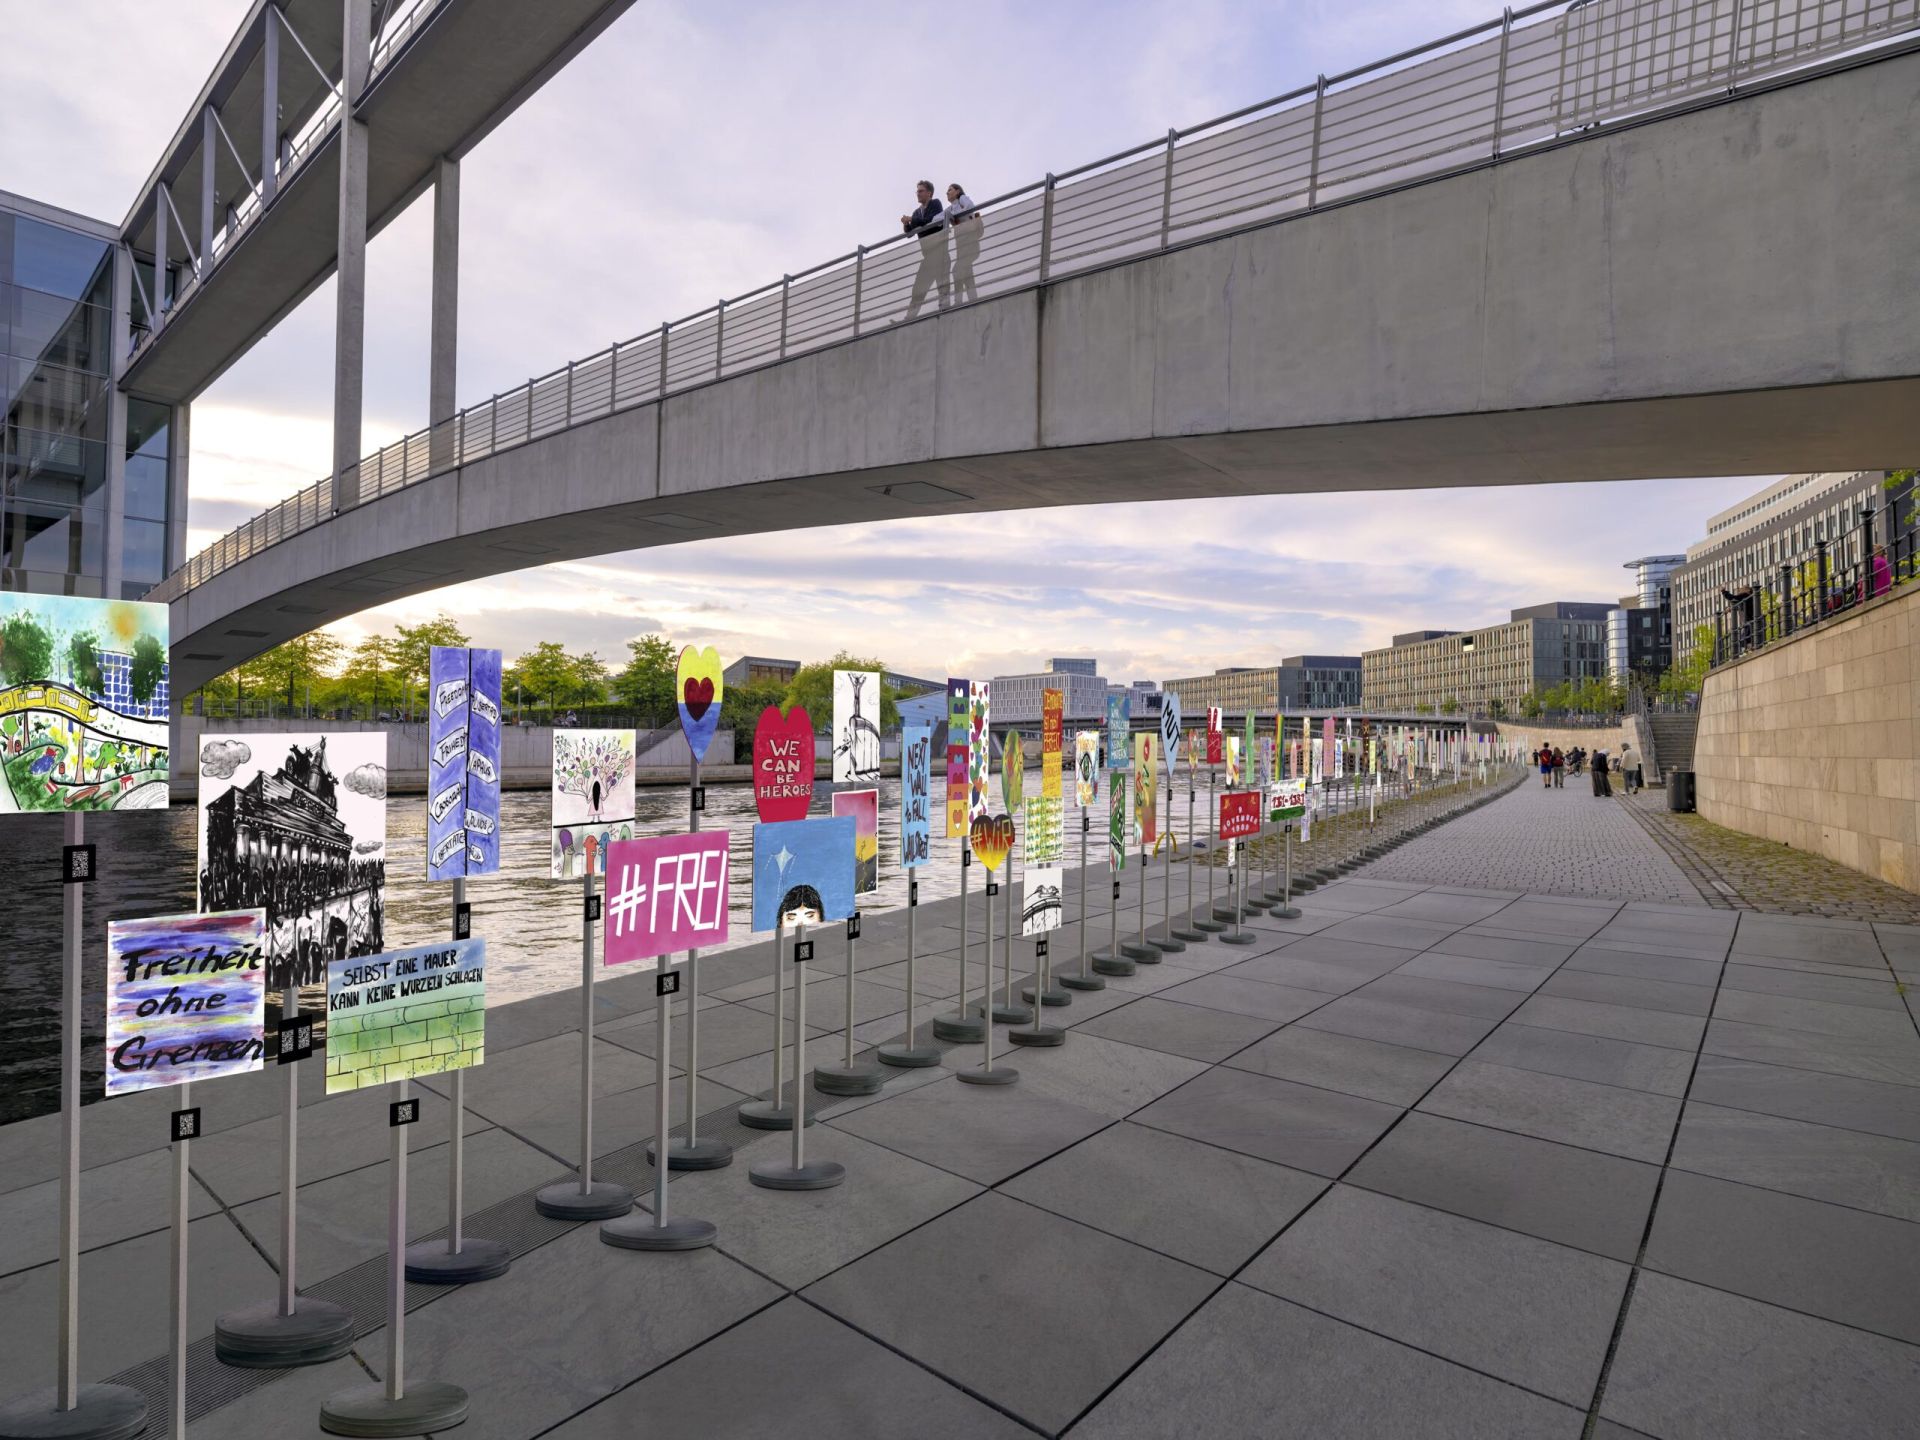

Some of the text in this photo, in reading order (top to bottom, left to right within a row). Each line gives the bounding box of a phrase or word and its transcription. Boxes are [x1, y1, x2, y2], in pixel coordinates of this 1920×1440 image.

[1162, 700, 1181, 752] MUT
[769, 739, 800, 757] WE
[907, 737, 929, 783] NEXT
[761, 758, 801, 773] CAN
[776, 773, 796, 784] BE
[760, 783, 811, 799] HEROES
[910, 769, 928, 798] WALL
[912, 798, 928, 822] FALL
[609, 850, 728, 937] #FREI
[120, 943, 267, 982] Freiheit
[342, 949, 457, 987] SELBST EINE MAUER
[136, 986, 227, 1017] ohne
[330, 968, 483, 1012] KANN KEINE WURZELN SCHLAGEN
[112, 1035, 264, 1072] Grenzen
